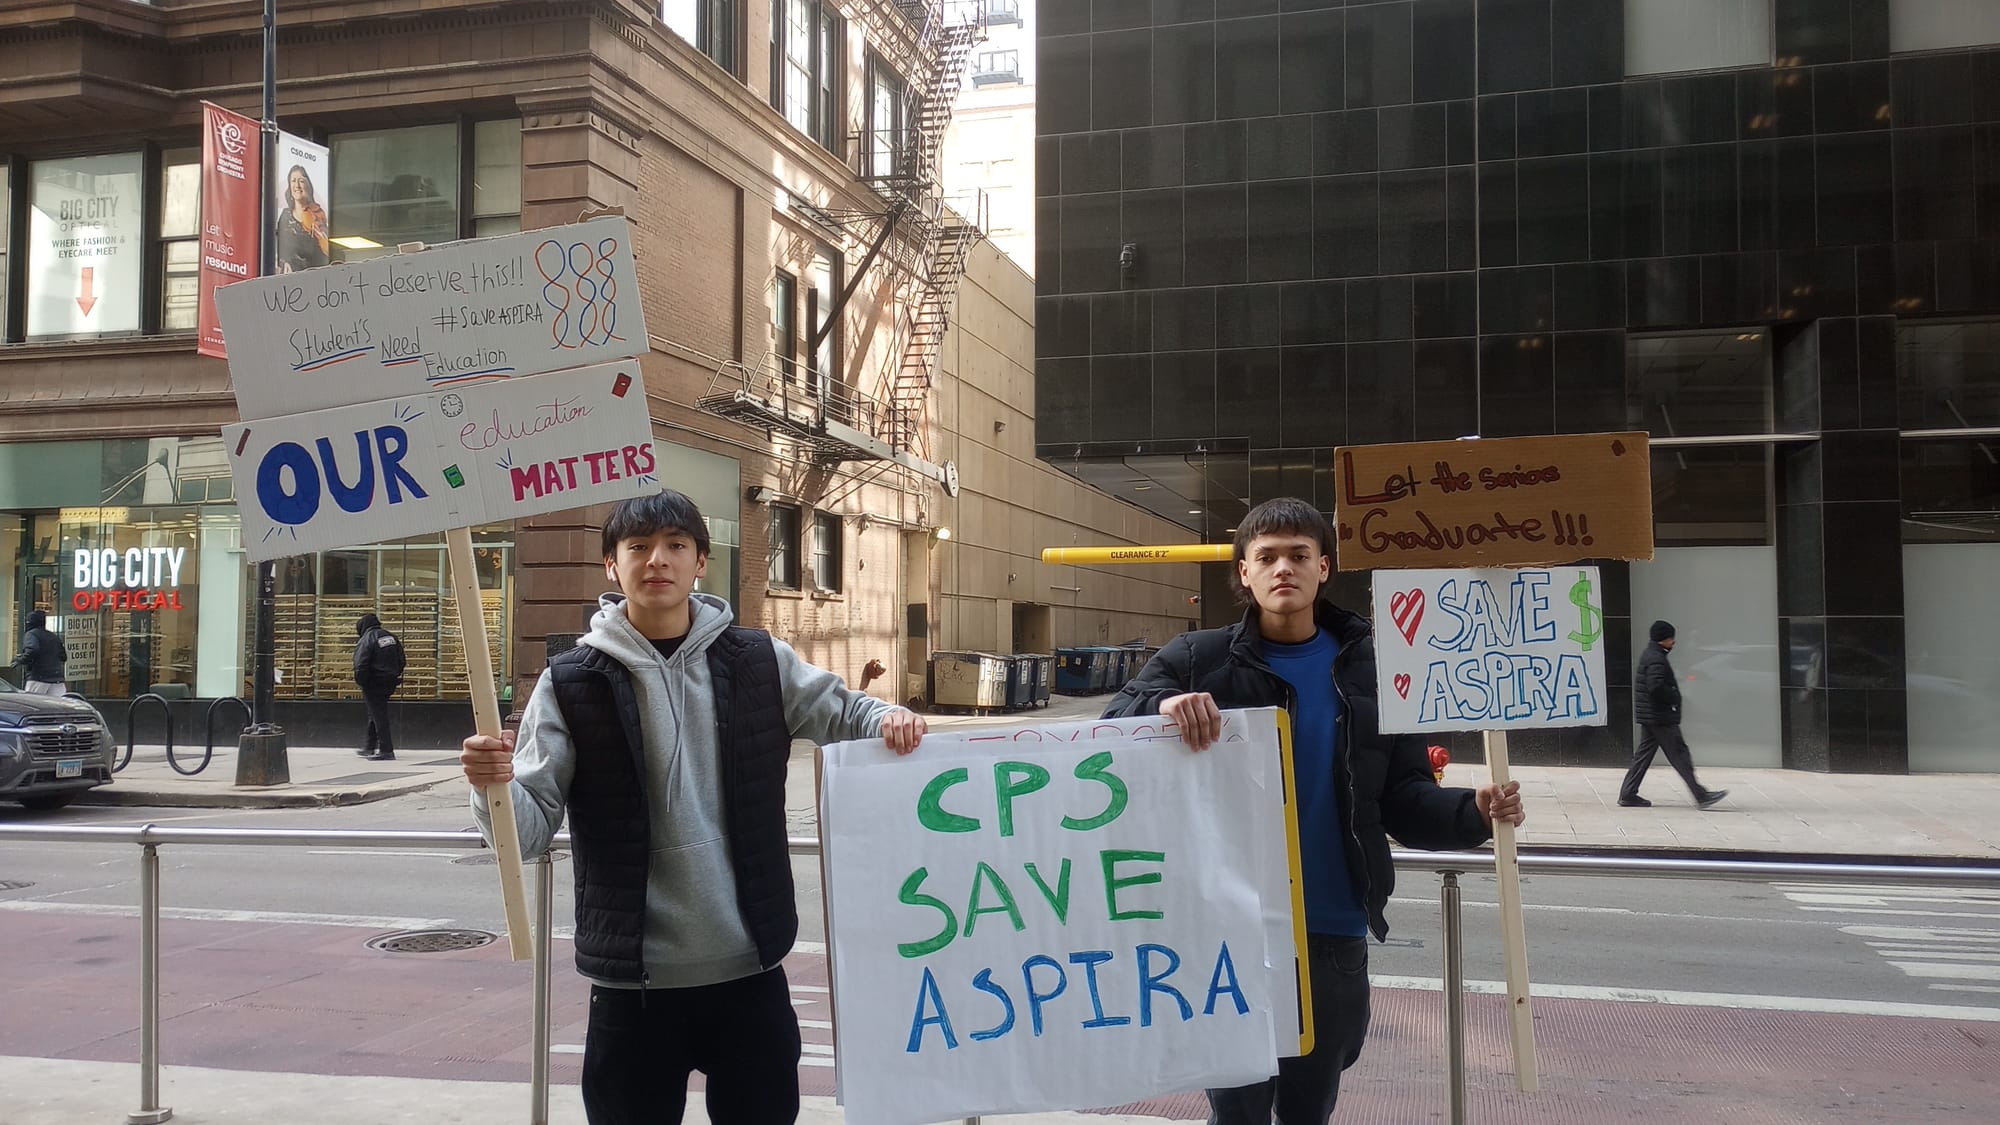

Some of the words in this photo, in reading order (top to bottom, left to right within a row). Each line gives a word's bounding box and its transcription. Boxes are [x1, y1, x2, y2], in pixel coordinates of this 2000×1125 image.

[291, 147, 317, 162] CSO.ORG
[60, 199, 83, 220] BIG
[87, 196, 119, 219] CITY
[52, 238, 80, 248] WHERE
[84, 235, 117, 245] FASHION
[205, 220, 220, 236] Let
[59, 248, 92, 258] EYECARE
[96, 246, 118, 256] MEET
[205, 239, 234, 256] music
[205, 255, 247, 275] resound
[317, 272, 370, 309] don't
[379, 263, 464, 297] deserve
[423, 347, 508, 379] Education
[459, 395, 594, 451] education
[256, 423, 429, 527] OUR
[509, 442, 656, 503] MATTERS
[1343, 451, 1421, 506] Let
[1430, 461, 1473, 494] the
[74, 547, 118, 589] BIG
[124, 547, 185, 588] CITY
[1110, 551, 1154, 559] CLEARANCE
[72, 589, 184, 611] OPTICAL
[1427, 571, 1556, 654] SAVE
[67, 618, 81, 630] BIG
[82, 617, 97, 630] CITY
[67, 642, 79, 651] USE
[81, 641, 88, 650] IT
[71, 651, 87, 660] LOSE
[1416, 651, 1598, 724] ASPIRA
[916, 750, 1129, 838] CPS
[896, 849, 1166, 960] SAVE
[905, 940, 1251, 1054] ASPIRA
